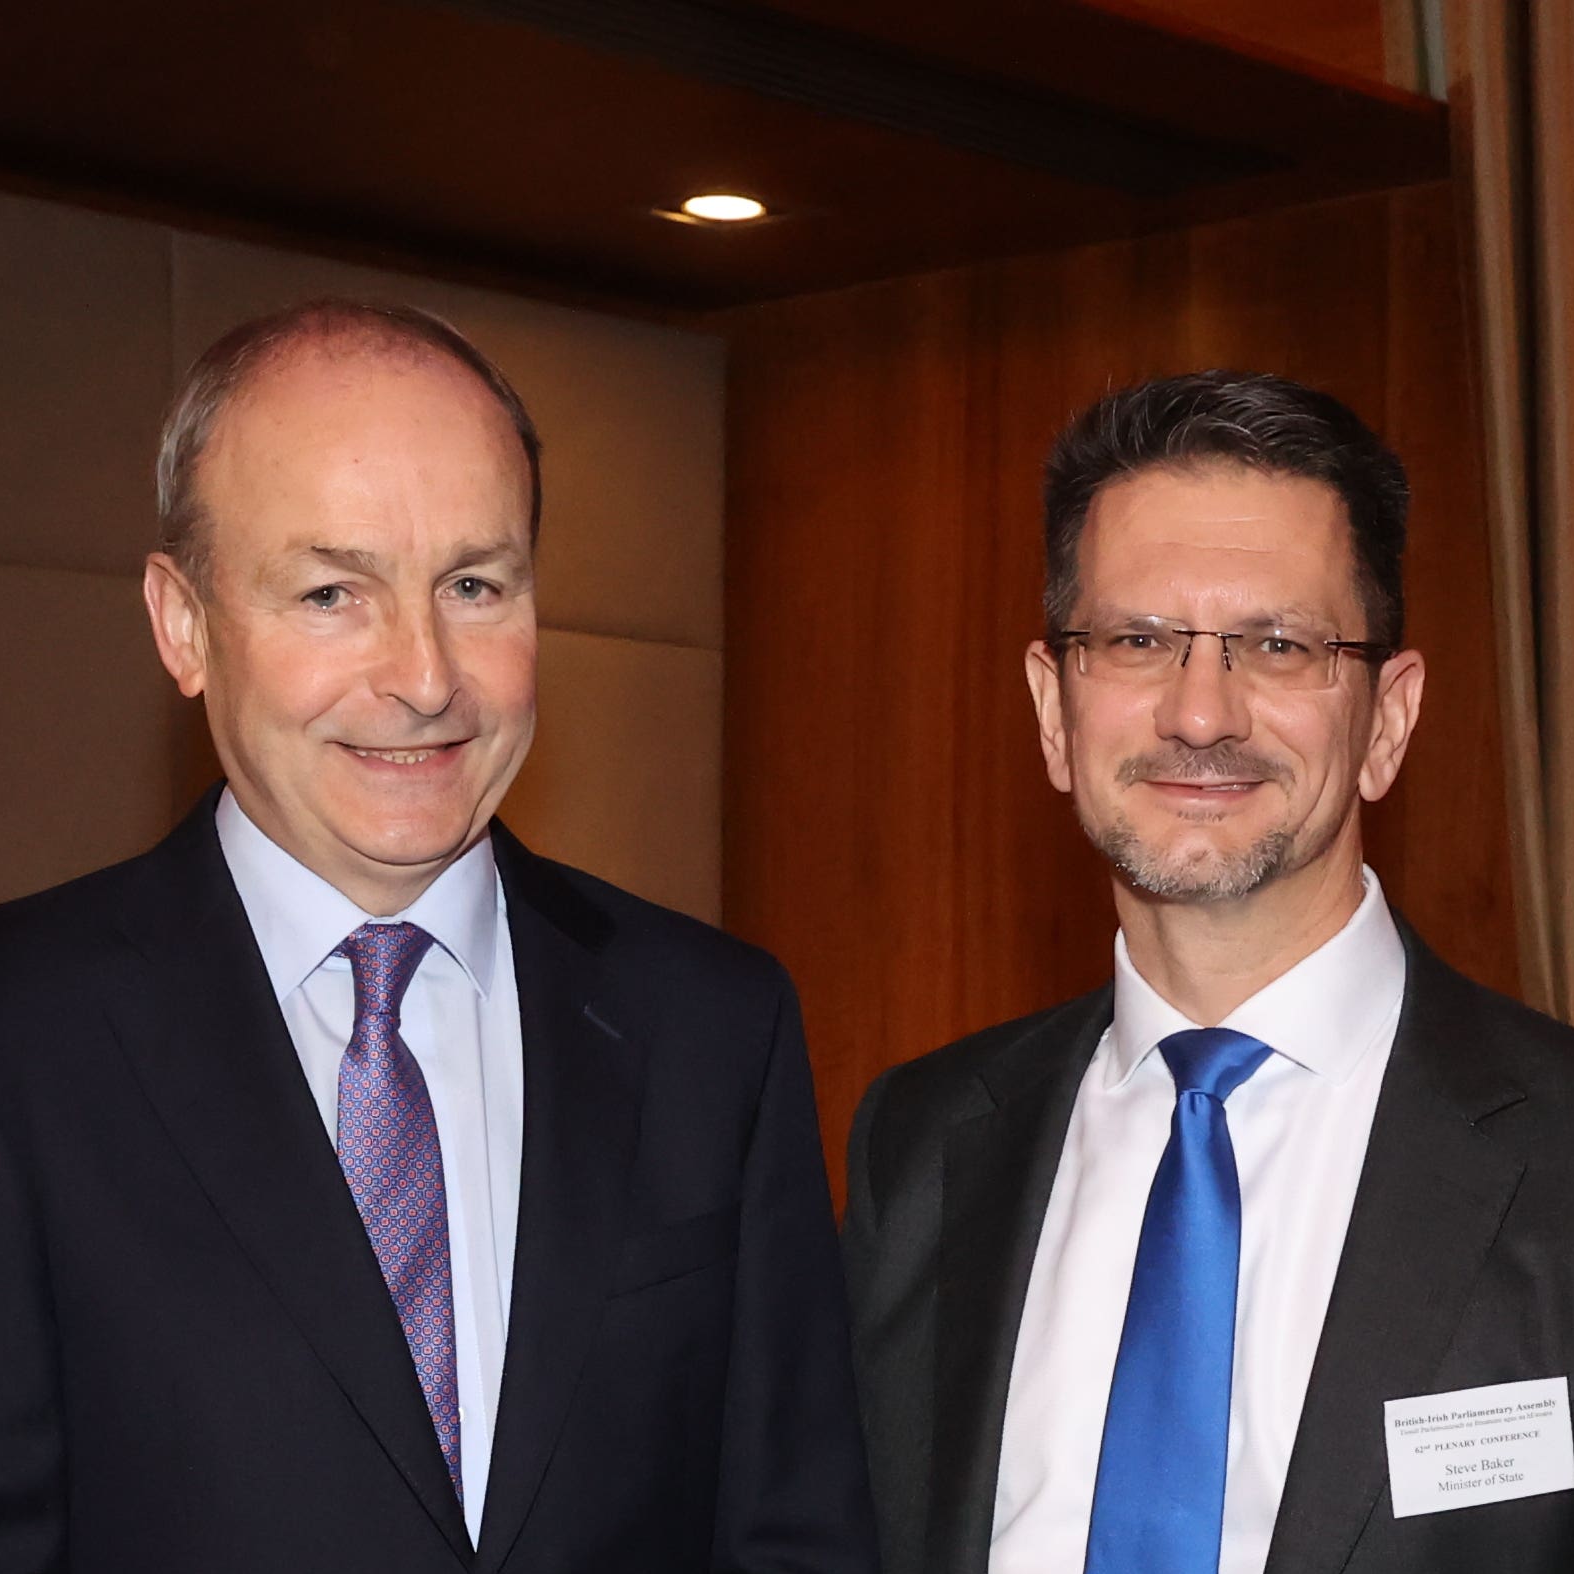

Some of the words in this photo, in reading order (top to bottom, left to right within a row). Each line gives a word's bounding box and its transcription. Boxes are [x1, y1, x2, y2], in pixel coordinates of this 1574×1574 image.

[1394, 1413, 1449, 1428] British-Irish
[1451, 1406, 1513, 1420] Parliamentary
[1516, 1399, 1556, 1411] Assembly
[1434, 1439, 1475, 1451] PLENARY
[1480, 1430, 1540, 1445] CONFERENCE
[1445, 1463, 1477, 1475] Steve
[1480, 1457, 1515, 1471] Baker
[1438, 1479, 1482, 1491] Minister
[1484, 1473, 1497, 1486] of
[1498, 1473, 1524, 1483] State
